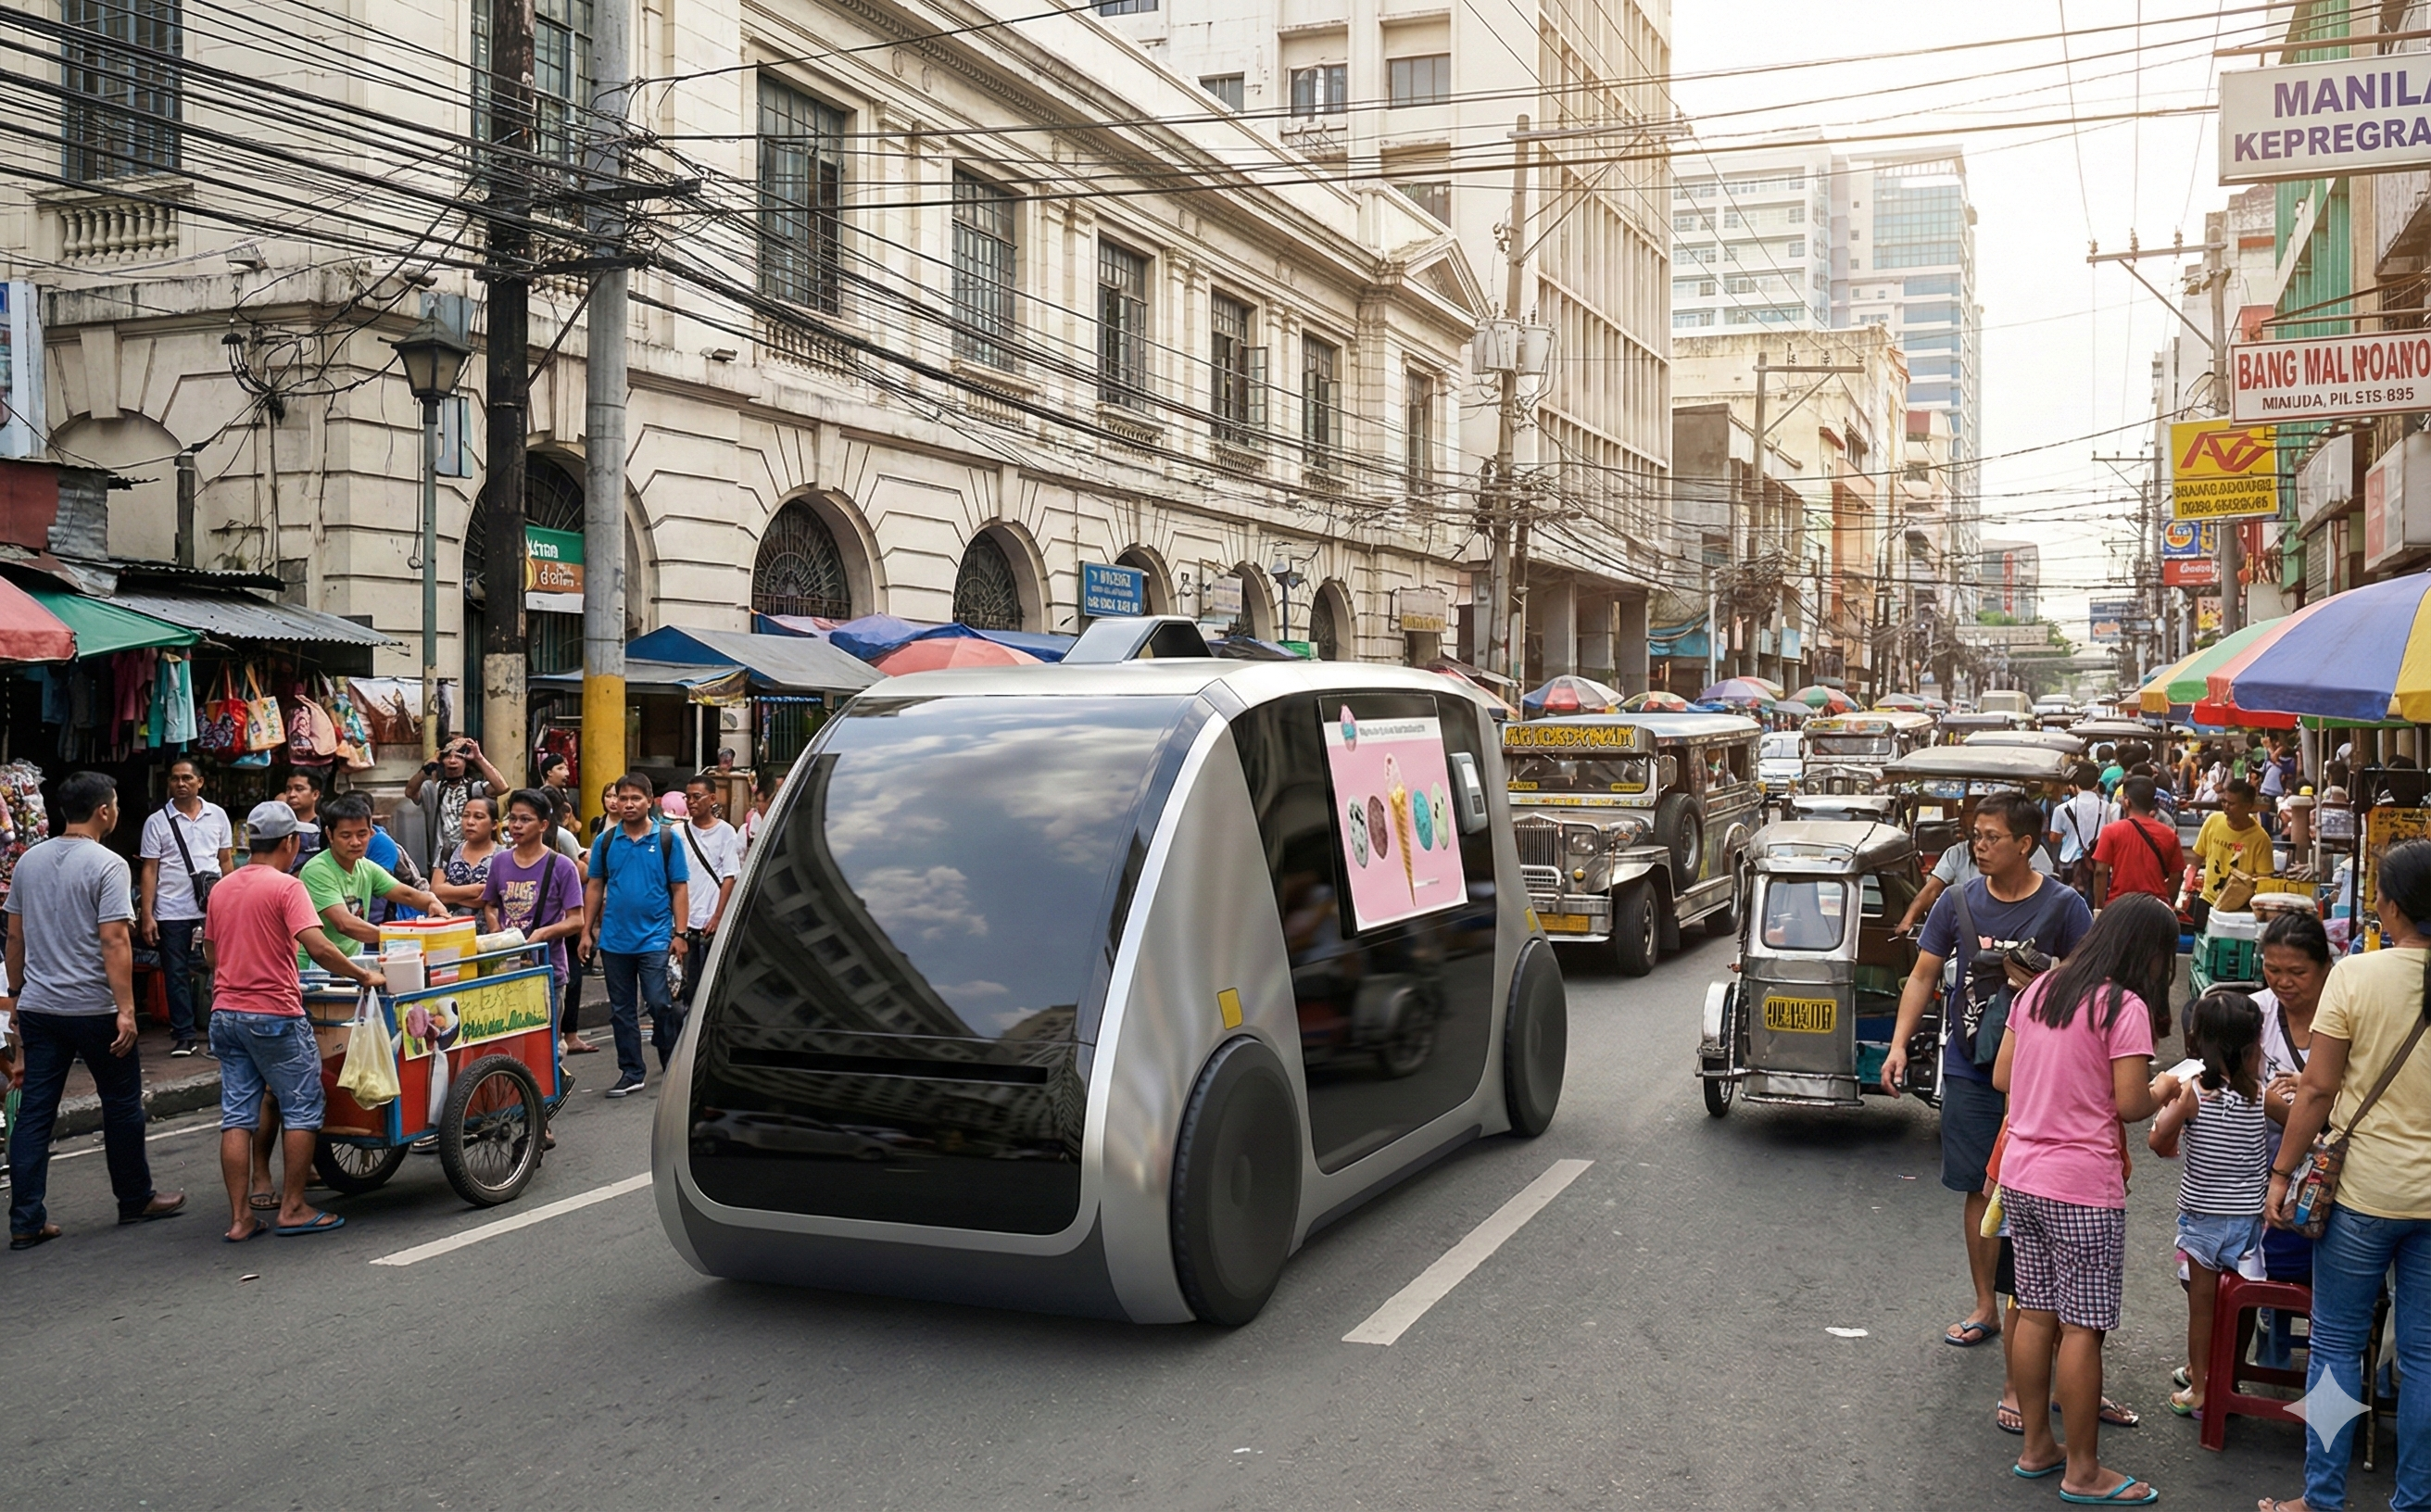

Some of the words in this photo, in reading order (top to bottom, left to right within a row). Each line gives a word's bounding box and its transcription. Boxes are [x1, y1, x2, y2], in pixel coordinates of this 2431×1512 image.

[2274, 69, 2431, 118] MANIL
[2235, 117, 2431, 162] KEPREGRA
[2238, 349, 2297, 391] BANG
